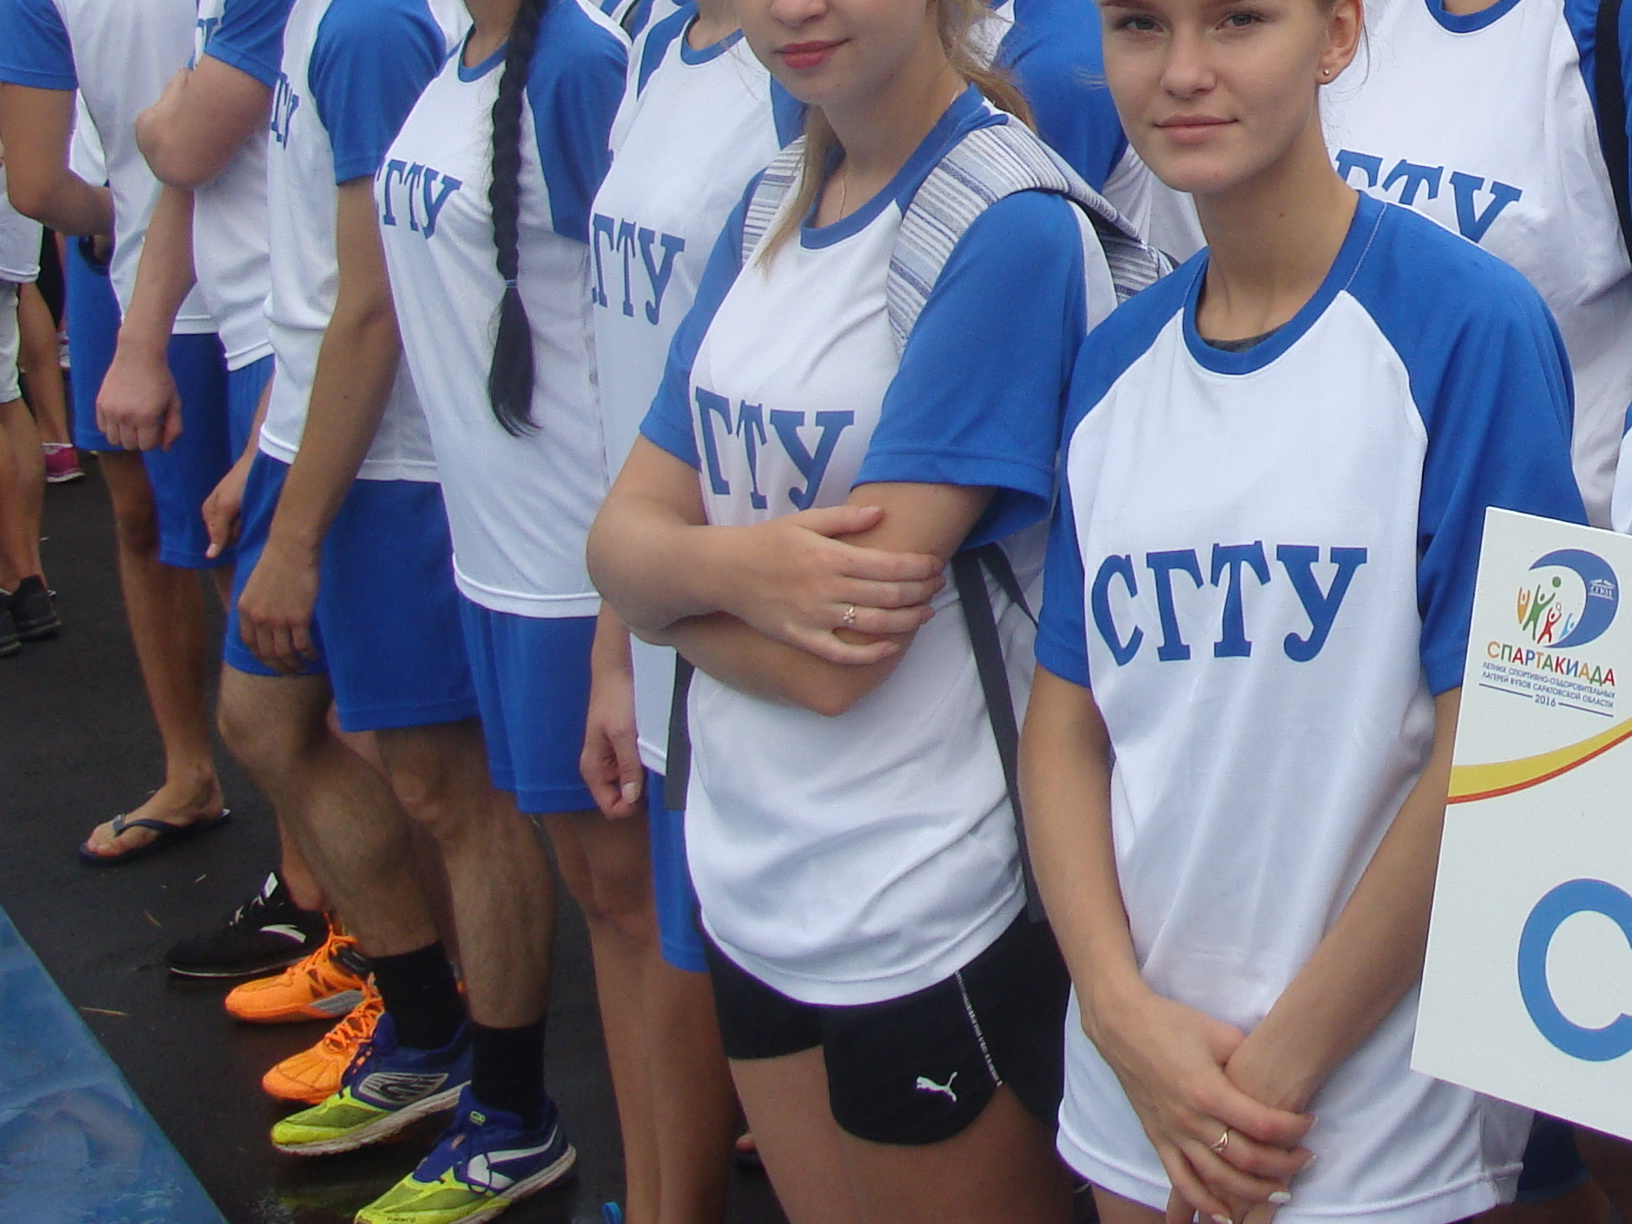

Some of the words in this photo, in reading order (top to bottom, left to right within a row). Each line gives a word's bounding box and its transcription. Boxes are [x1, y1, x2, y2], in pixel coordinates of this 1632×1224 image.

[374, 158, 463, 240] ГТУ
[592, 212, 687, 326] ГТУ
[695, 385, 856, 512] ГТУ
[1091, 540, 1368, 667] СГТУ
[1486, 640, 1616, 687] СПАРТАКИАДА
[1534, 693, 1557, 707] 2016
